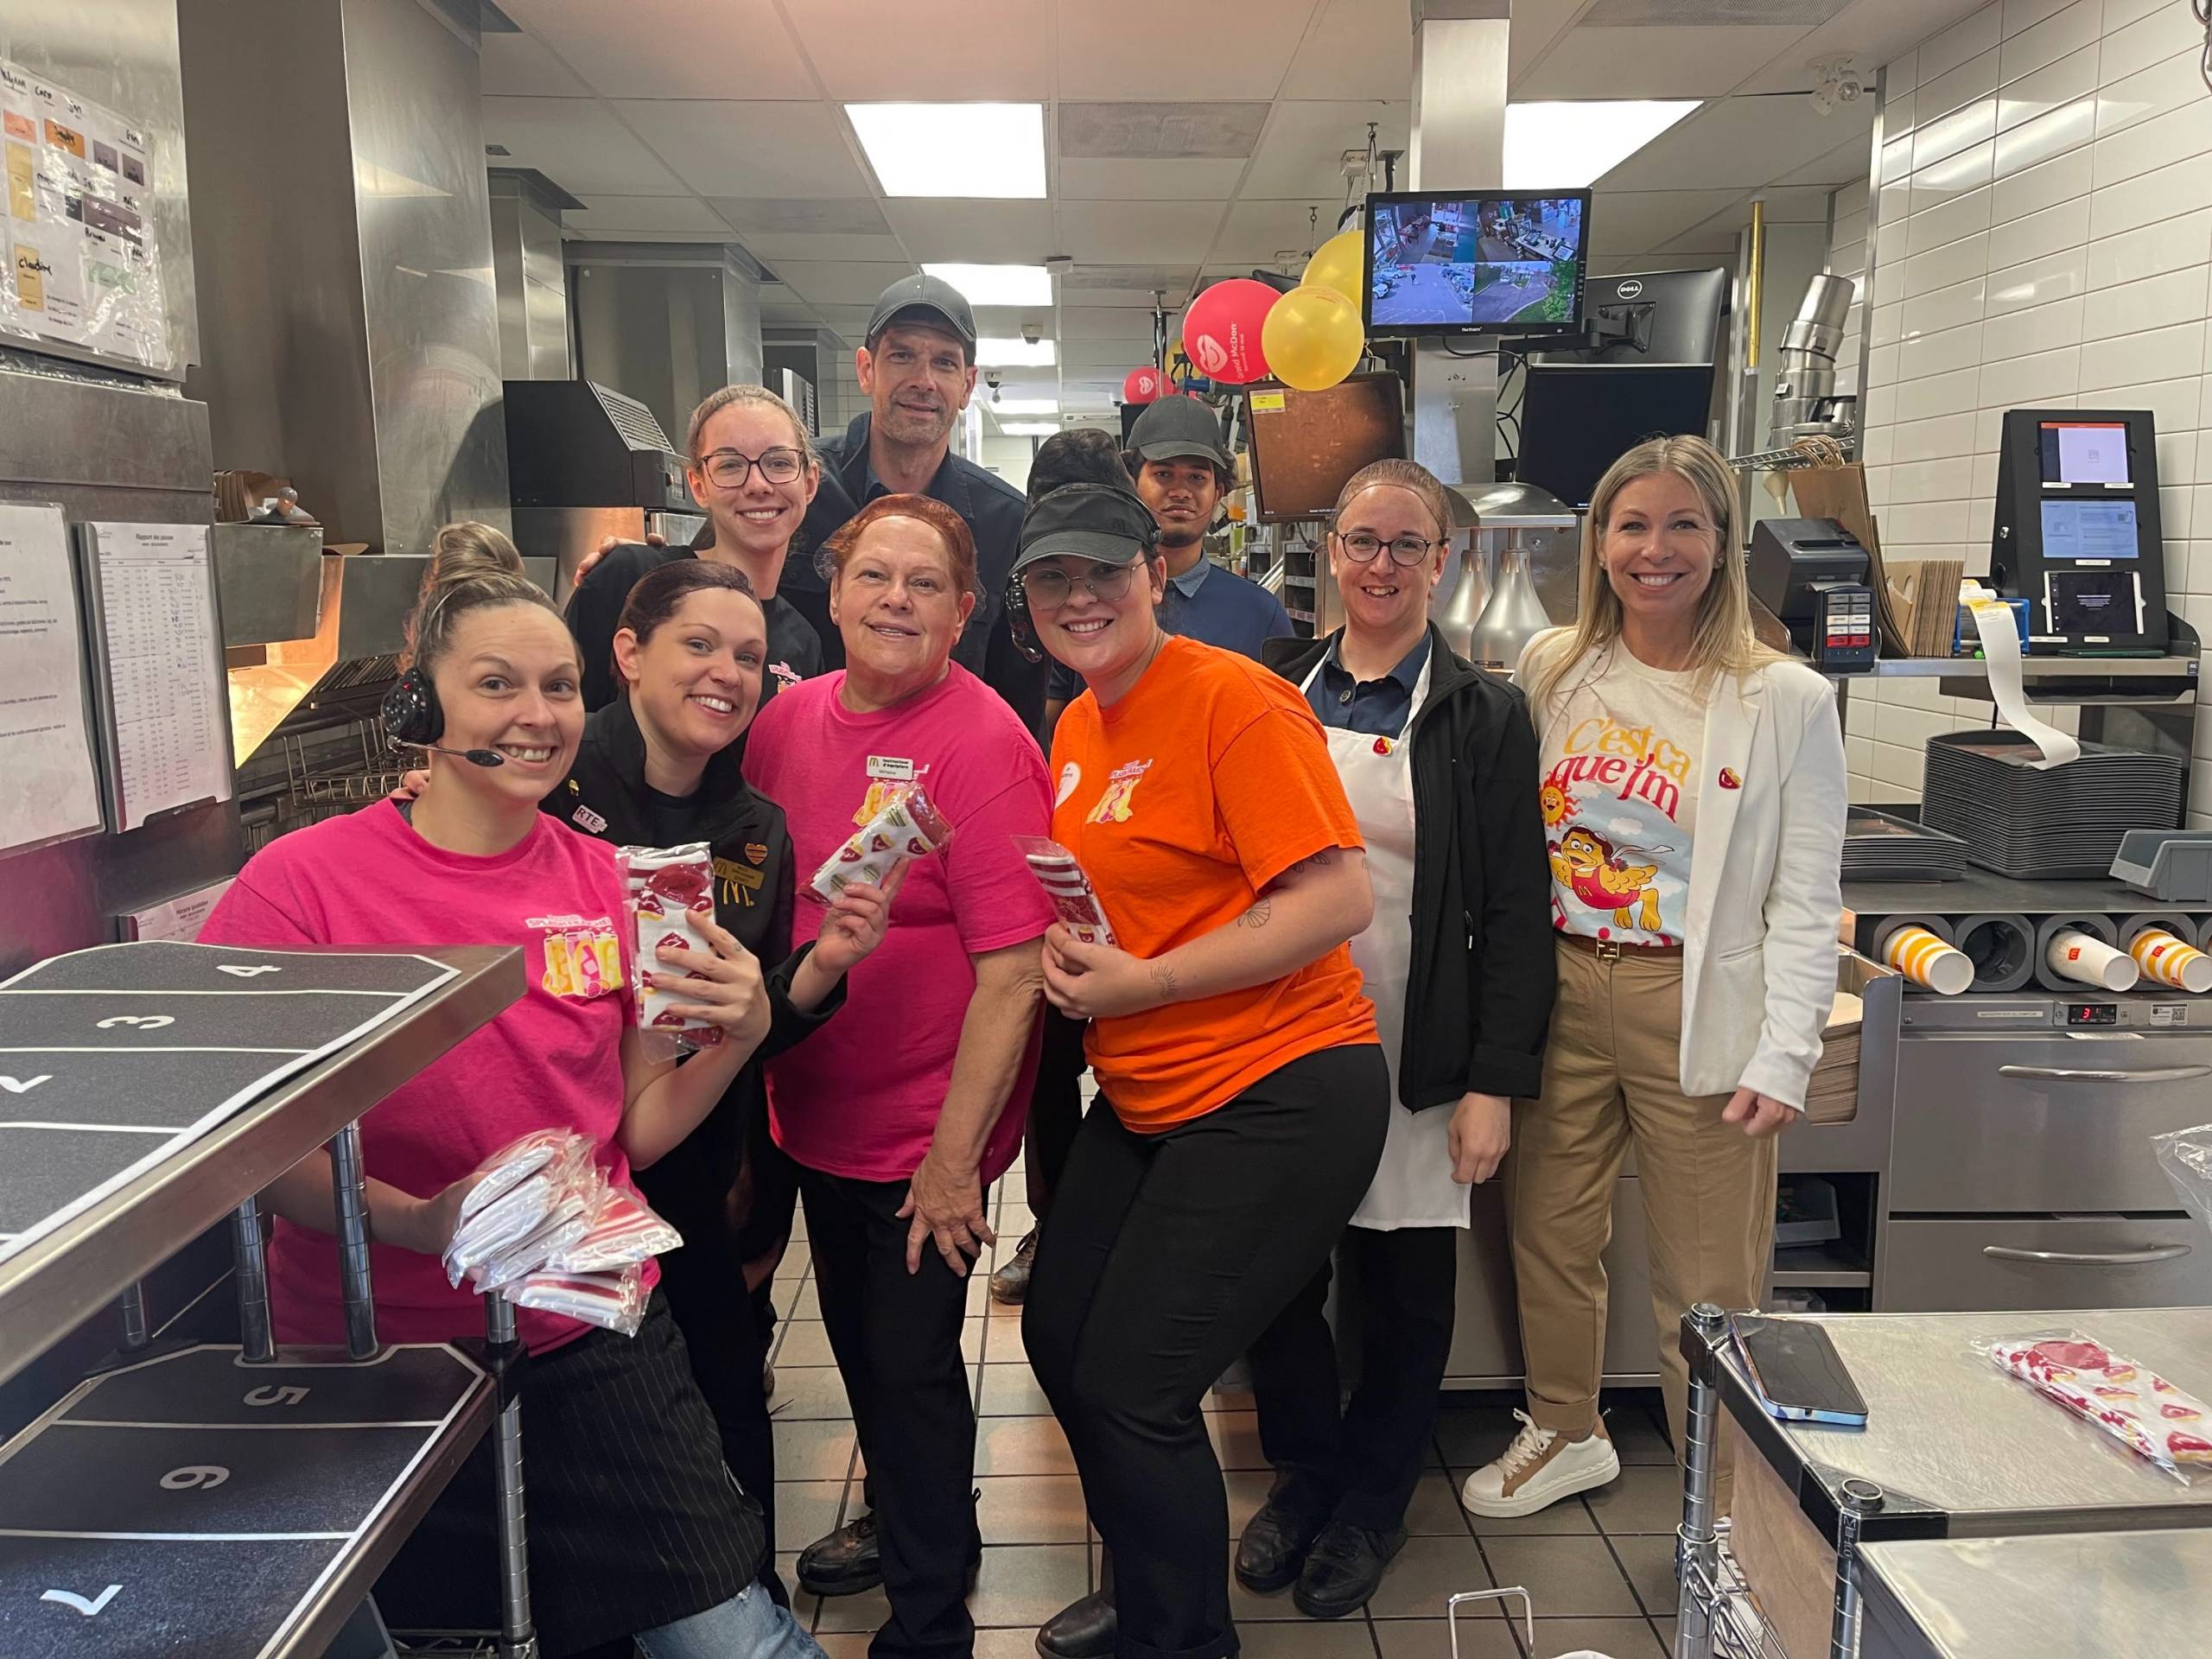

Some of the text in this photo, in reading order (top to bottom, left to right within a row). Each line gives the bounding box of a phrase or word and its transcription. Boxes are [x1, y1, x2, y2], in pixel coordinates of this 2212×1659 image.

[1563, 718, 1655, 760] C'est
[1551, 755, 1628, 790] que
[576, 807, 601, 828] RTE
[216, 963, 283, 978] 4
[96, 1014, 175, 1030] 3
[2081, 1007, 2091, 1019] 3
[242, 1384, 312, 1407] 5
